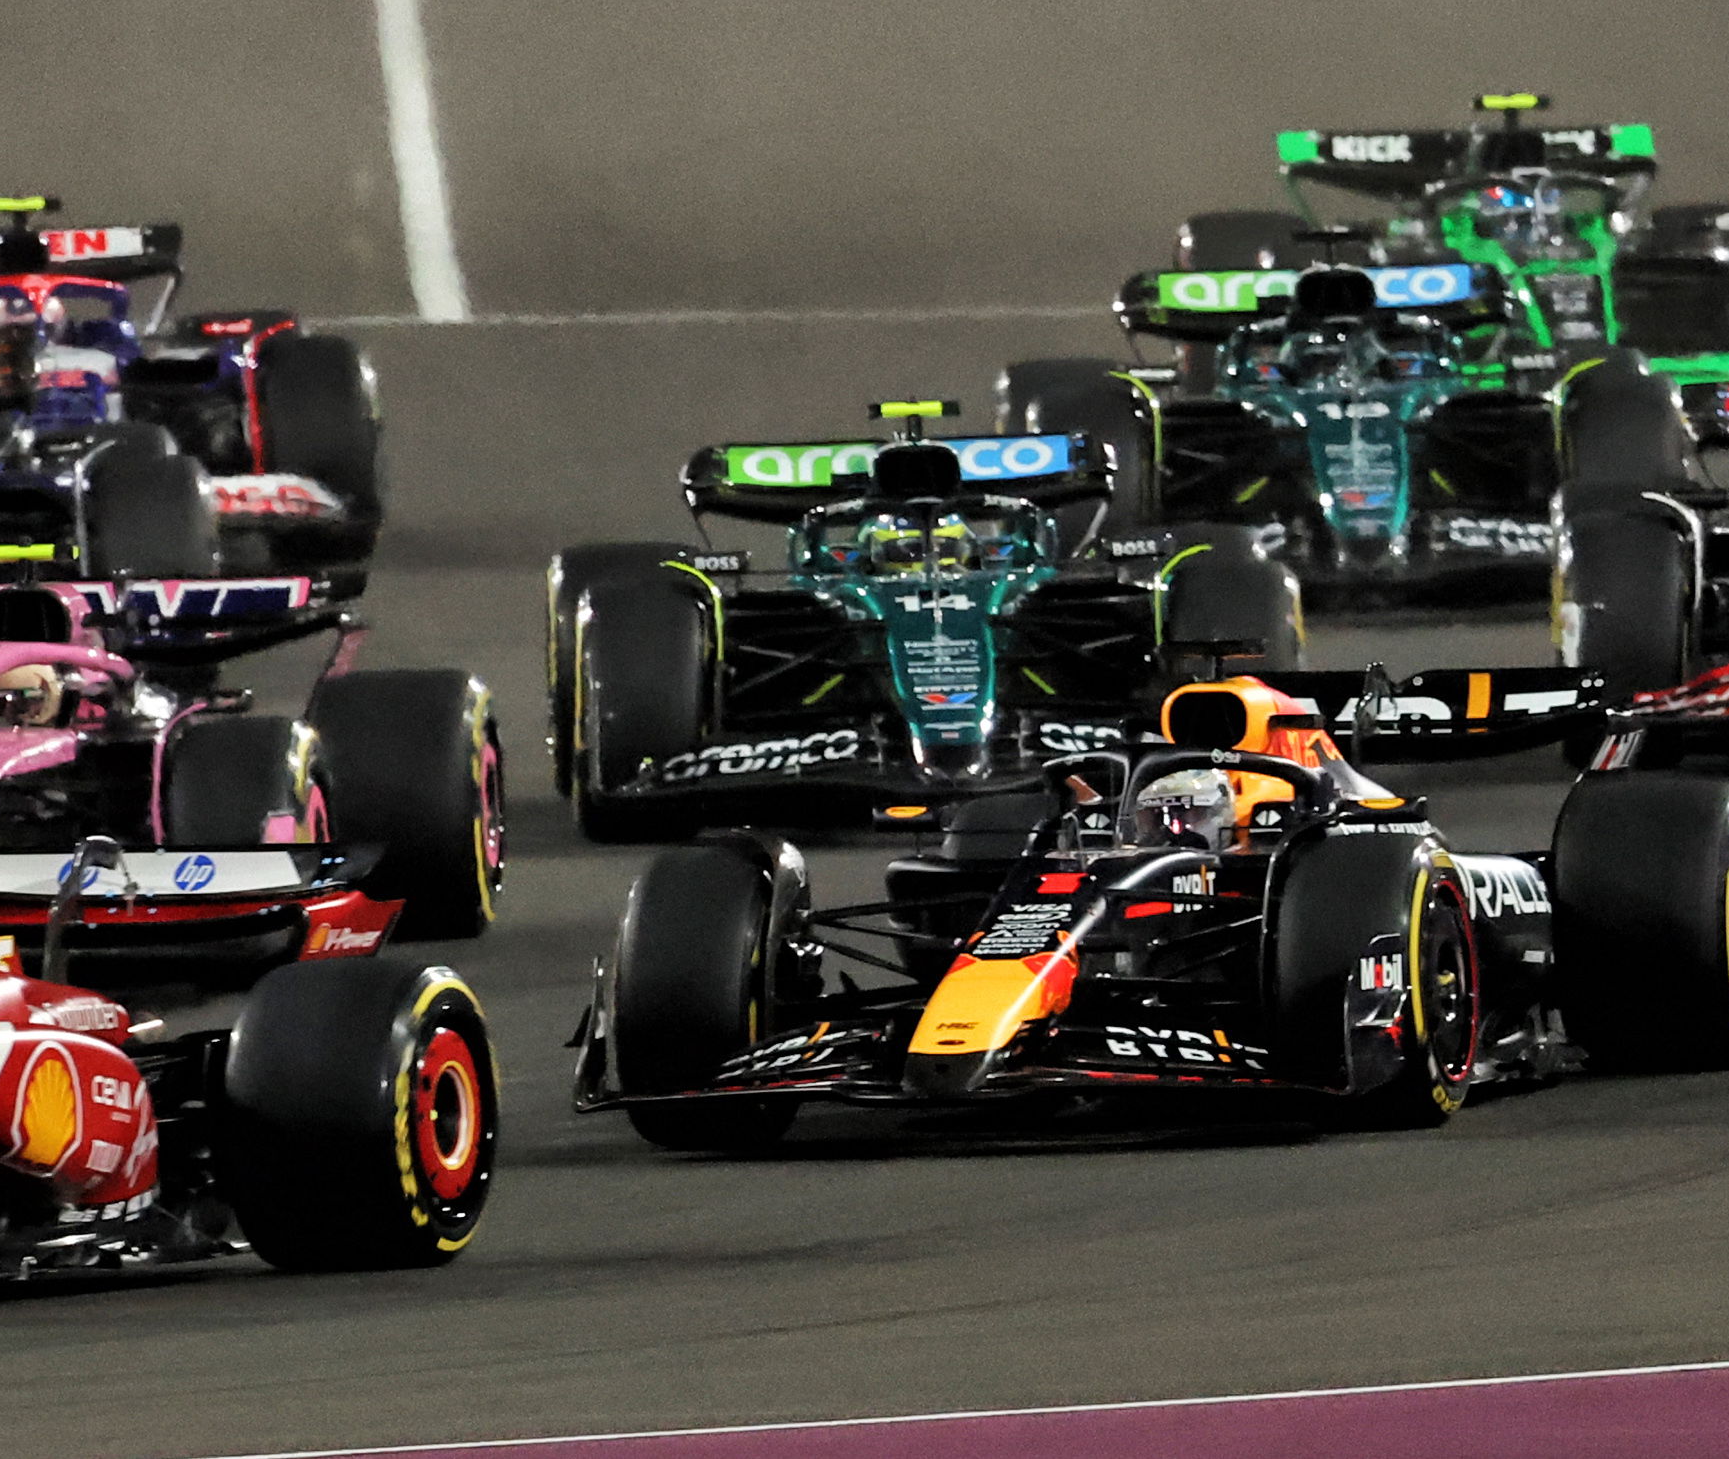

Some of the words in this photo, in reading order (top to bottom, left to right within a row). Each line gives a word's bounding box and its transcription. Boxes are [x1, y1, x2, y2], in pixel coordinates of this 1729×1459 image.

[1331, 135, 1413, 162] KICK
[1173, 270, 1458, 309] araco
[741, 439, 1054, 485] araco
[694, 555, 740, 571] BOSS
[1112, 540, 1158, 557] BOSS
[894, 594, 977, 612] 14
[662, 730, 859, 783] aramco
[176, 855, 214, 892] hp
[1359, 952, 1404, 991] Mobil
